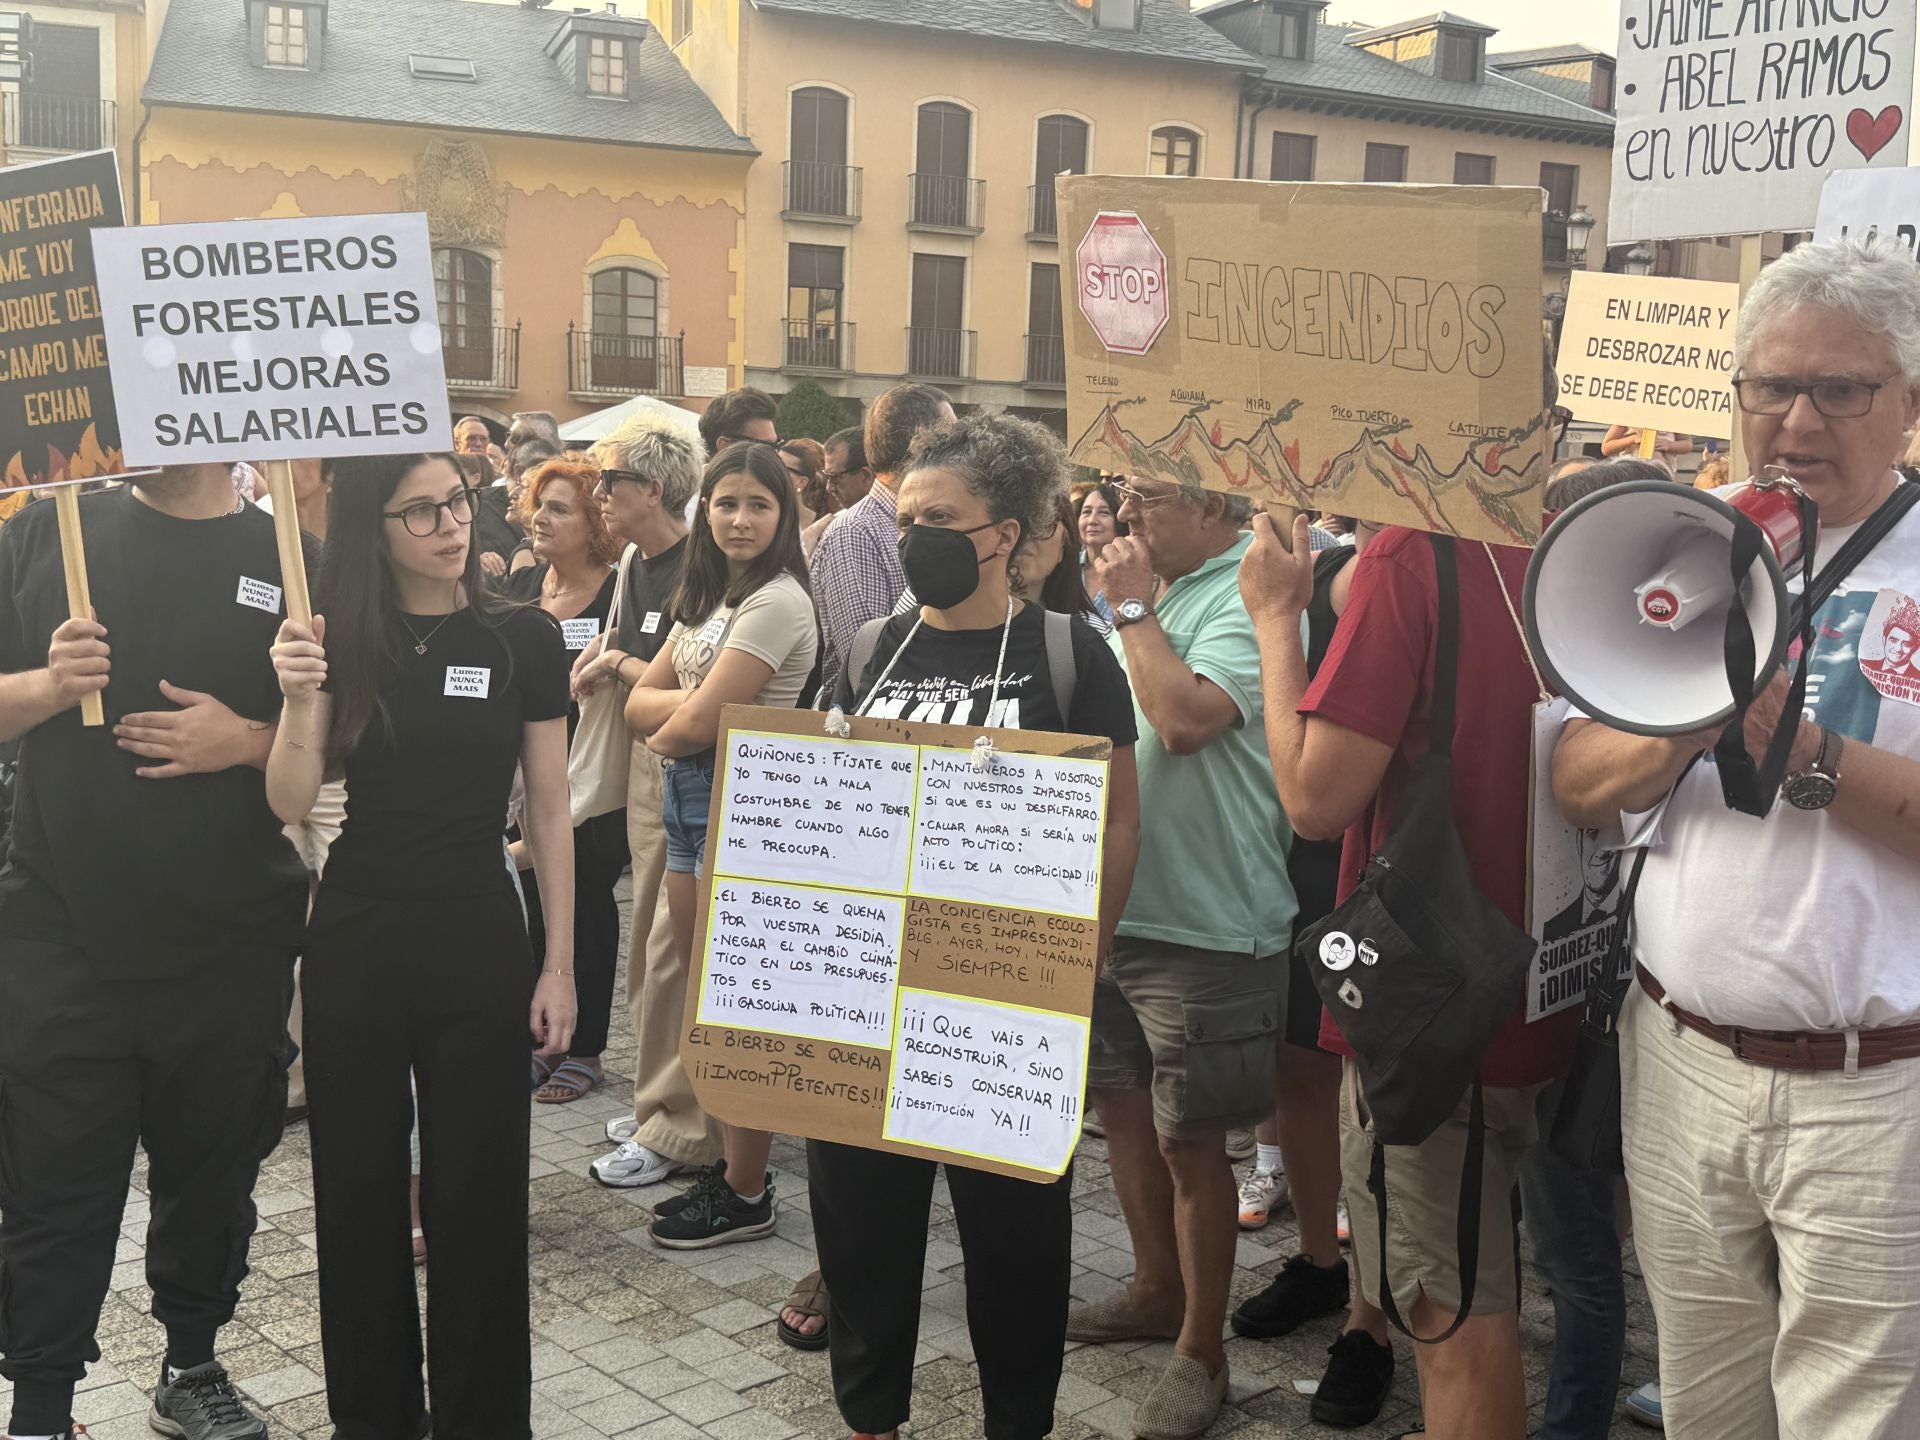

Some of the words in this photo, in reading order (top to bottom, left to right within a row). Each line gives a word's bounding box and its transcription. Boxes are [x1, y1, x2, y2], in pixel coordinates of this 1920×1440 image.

[1660, 48, 1746, 112] ABEL
[1756, 28, 1894, 102] RAMOS
[1626, 128, 1674, 181] en
[1686, 114, 1835, 176] nuestro
[0, 247, 31, 283] ME
[35, 239, 74, 276] VOY
[141, 234, 397, 281] BOMBEROS
[1084, 263, 1160, 304] STOP
[65, 285, 103, 322] DEL
[133, 290, 420, 337] FORESTALES
[1606, 298, 1631, 320] EN
[1635, 301, 1711, 328] LIMPIAR
[1718, 308, 1731, 329] Y
[1185, 257, 1506, 378] INCENDIOS
[72, 335, 108, 370] ME
[1586, 337, 1700, 368] DESBROZAR
[1706, 349, 1734, 372] NO
[177, 352, 391, 395] MEJORAS
[1086, 376, 1119, 387] TELENO
[1561, 374, 1584, 395] SE
[1589, 377, 1638, 402] DEBE
[1642, 383, 1732, 413] RECORTA
[24, 386, 92, 426] ECHAN
[1330, 405, 1352, 418] PICO
[1356, 410, 1398, 424] TUERTO
[154, 402, 428, 447] SALARIALES
[242, 587, 274, 600] NUNCA
[245, 596, 270, 607] MAIS
[945, 688, 969, 702] SER
[734, 767, 750, 779] YO
[763, 771, 801, 783] TENGO
[814, 776, 828, 787] LA
[839, 779, 871, 791] MALA
[891, 761, 912, 773] QUE
[1035, 769, 1043, 780] A
[1055, 771, 1103, 787] VOSOTROS
[927, 778, 950, 789] CON
[964, 781, 1023, 794] NUESTROS
[1033, 786, 1091, 802] IMPUESTOS
[734, 793, 811, 809] COSTUMBRE
[825, 800, 842, 810] DE
[856, 803, 872, 812] NO
[881, 804, 910, 818] TENER
[946, 798, 968, 807] QUE
[976, 800, 992, 808] ES
[1001, 802, 1016, 810] UN
[1026, 803, 1100, 821] DESPILFARRO.
[732, 814, 782, 827] HAMBRE
[795, 820, 843, 833] CUANDO
[859, 826, 889, 838] ALGO
[927, 820, 966, 832] CALLAR
[976, 824, 1009, 836] AHORA
[1082, 833, 1097, 843] UN
[728, 838, 747, 848] ME
[762, 840, 836, 859] PREOCUPA.
[923, 836, 949, 846] ACTO
[964, 861, 979, 871] DE
[989, 863, 1002, 873] LA
[721, 890, 737, 902] EL
[752, 892, 801, 910] BIERZO
[813, 901, 829, 913] SE
[843, 904, 886, 921] QUEMA
[910, 900, 930, 913] LA
[940, 903, 1036, 927] CONCIENCIA
[720, 911, 746, 927] POR
[763, 918, 820, 935] VUESTRA
[907, 914, 950, 931] GISTA
[961, 922, 981, 935] ES
[720, 935, 766, 950] NEGAR
[780, 941, 794, 951] EL
[804, 943, 848, 957] CAMBIO
[716, 952, 746, 965] TICO
[760, 958, 779, 968] EN
[790, 960, 813, 971] LOS
[908, 948, 919, 963] Y
[936, 954, 1030, 982] SIEMPRE
[1036, 950, 1093, 972] MAÑANA
[711, 974, 737, 986] TOS
[752, 979, 771, 990] ES
[1540, 944, 1631, 1012] ¡DIMISN
[689, 1028, 711, 1045] EL
[724, 1031, 785, 1052] BIERZO
[795, 1044, 815, 1058] SE
[829, 1048, 881, 1072] QUEMA
[992, 1030, 1024, 1046] VAIS
[1038, 1036, 1049, 1052] A
[1028, 1062, 1063, 1081] SINO
[903, 1068, 953, 1088] SABEIS
[972, 1079, 1052, 1109] CONSERVAR
